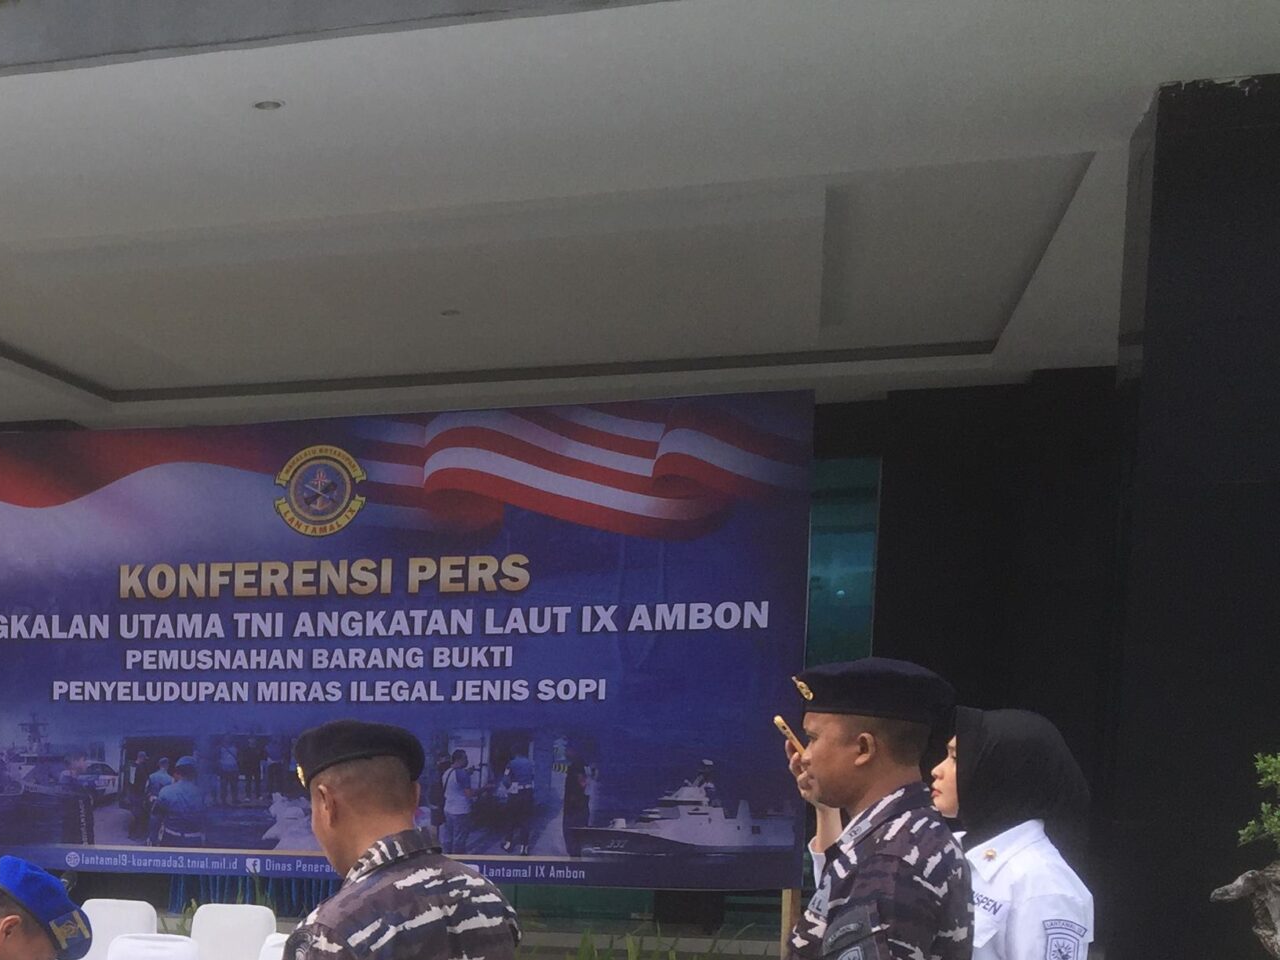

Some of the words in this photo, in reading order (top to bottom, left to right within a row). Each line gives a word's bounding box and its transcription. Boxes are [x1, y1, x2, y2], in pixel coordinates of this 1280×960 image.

[120, 557, 393, 598] KONFERENSI
[408, 554, 531, 594] PERS
[120, 613, 225, 639] UTAMA
[234, 612, 283, 638] TNI
[293, 609, 473, 638] ANGKATAN
[485, 606, 571, 635] LAUT
[582, 605, 619, 633] IX
[628, 601, 770, 632] AMBON
[126, 649, 304, 670] PEMUSNAHAN
[312, 648, 424, 669] BARANG
[433, 646, 513, 668] BUKTI
[53, 681, 249, 702] PENYELUDUPAN
[257, 681, 342, 702] MIRAS
[351, 681, 445, 702] ILEGAL
[451, 679, 530, 701] JENIS
[537, 678, 607, 700] SOPI
[265, 858, 292, 871] Dinas
[483, 864, 531, 878] Lantamal
[535, 866, 546, 878] IX
[549, 865, 586, 879] Ambon
